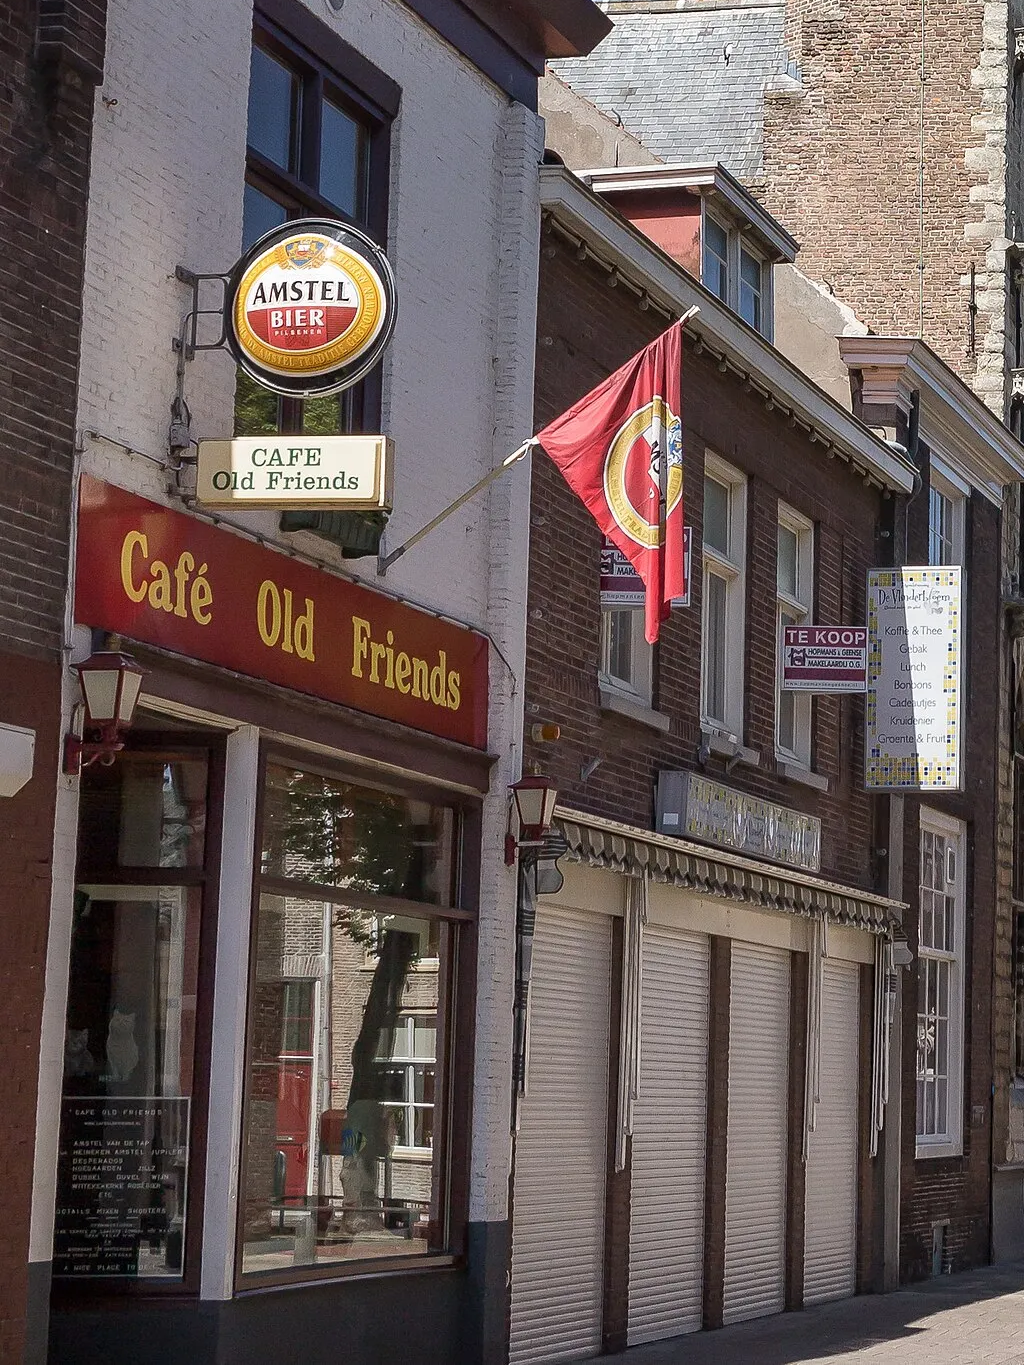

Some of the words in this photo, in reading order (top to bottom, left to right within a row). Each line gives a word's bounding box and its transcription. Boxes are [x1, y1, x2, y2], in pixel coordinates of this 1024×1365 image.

[253, 280, 350, 305] AMSTEL
[270, 309, 325, 328] BIER
[251, 447, 321, 467] CAFE
[212, 471, 255, 491] Old
[265, 471, 359, 490] Friends
[120, 529, 214, 626] Café
[256, 579, 315, 662] Old
[351, 615, 461, 712] Friends
[884, 626, 910, 635] Koffie
[912, 626, 919, 635] &
[920, 626, 943, 635] Thee
[786, 630, 809, 643] TE
[815, 630, 866, 645] KOOP
[808, 648, 837, 656] HOPMANS
[899, 644, 928, 654] Gebak
[900, 662, 927, 672] Lunch
[894, 680, 932, 690] Bonbons
[889, 698, 936, 710] Cadeautjes
[890, 716, 935, 725] Kruidenier
[878, 734, 915, 744] Groente
[916, 734, 924, 743] &
[926, 734, 946, 743] Fruit
[102, 1108, 118, 1116] OLD
